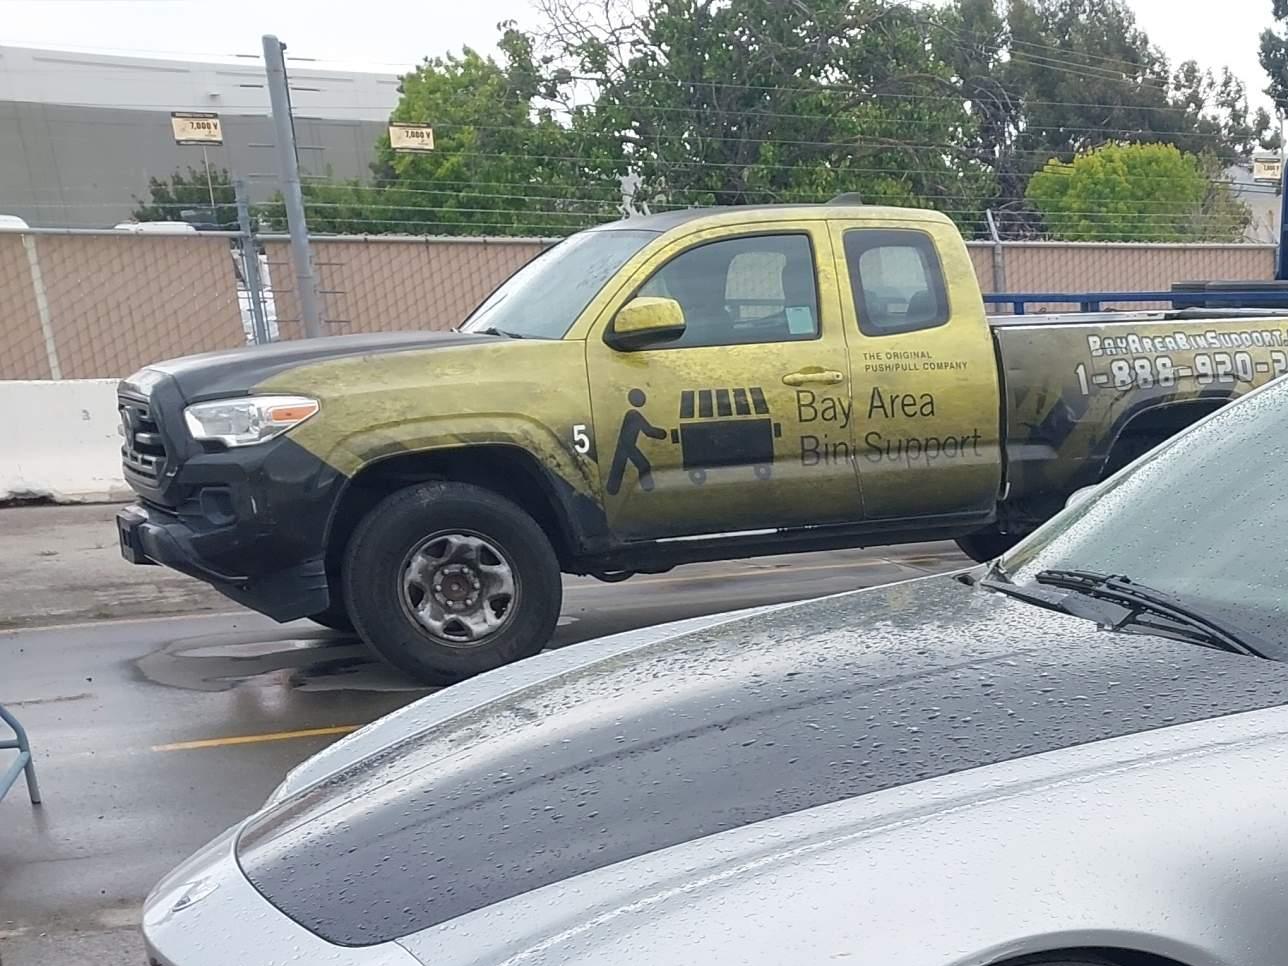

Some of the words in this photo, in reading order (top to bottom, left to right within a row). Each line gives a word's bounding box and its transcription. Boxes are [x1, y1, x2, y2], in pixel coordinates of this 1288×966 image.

[863, 352, 881, 360] THE
[885, 351, 932, 359] ORIGINAL
[865, 363, 920, 372] PUSH/PULL
[922, 361, 968, 371] COMPANY
[796, 390, 852, 429] Bay
[868, 387, 936, 419] Area
[573, 425, 590, 454] 5
[800, 434, 849, 467] Bin
[864, 428, 982, 468] Support
